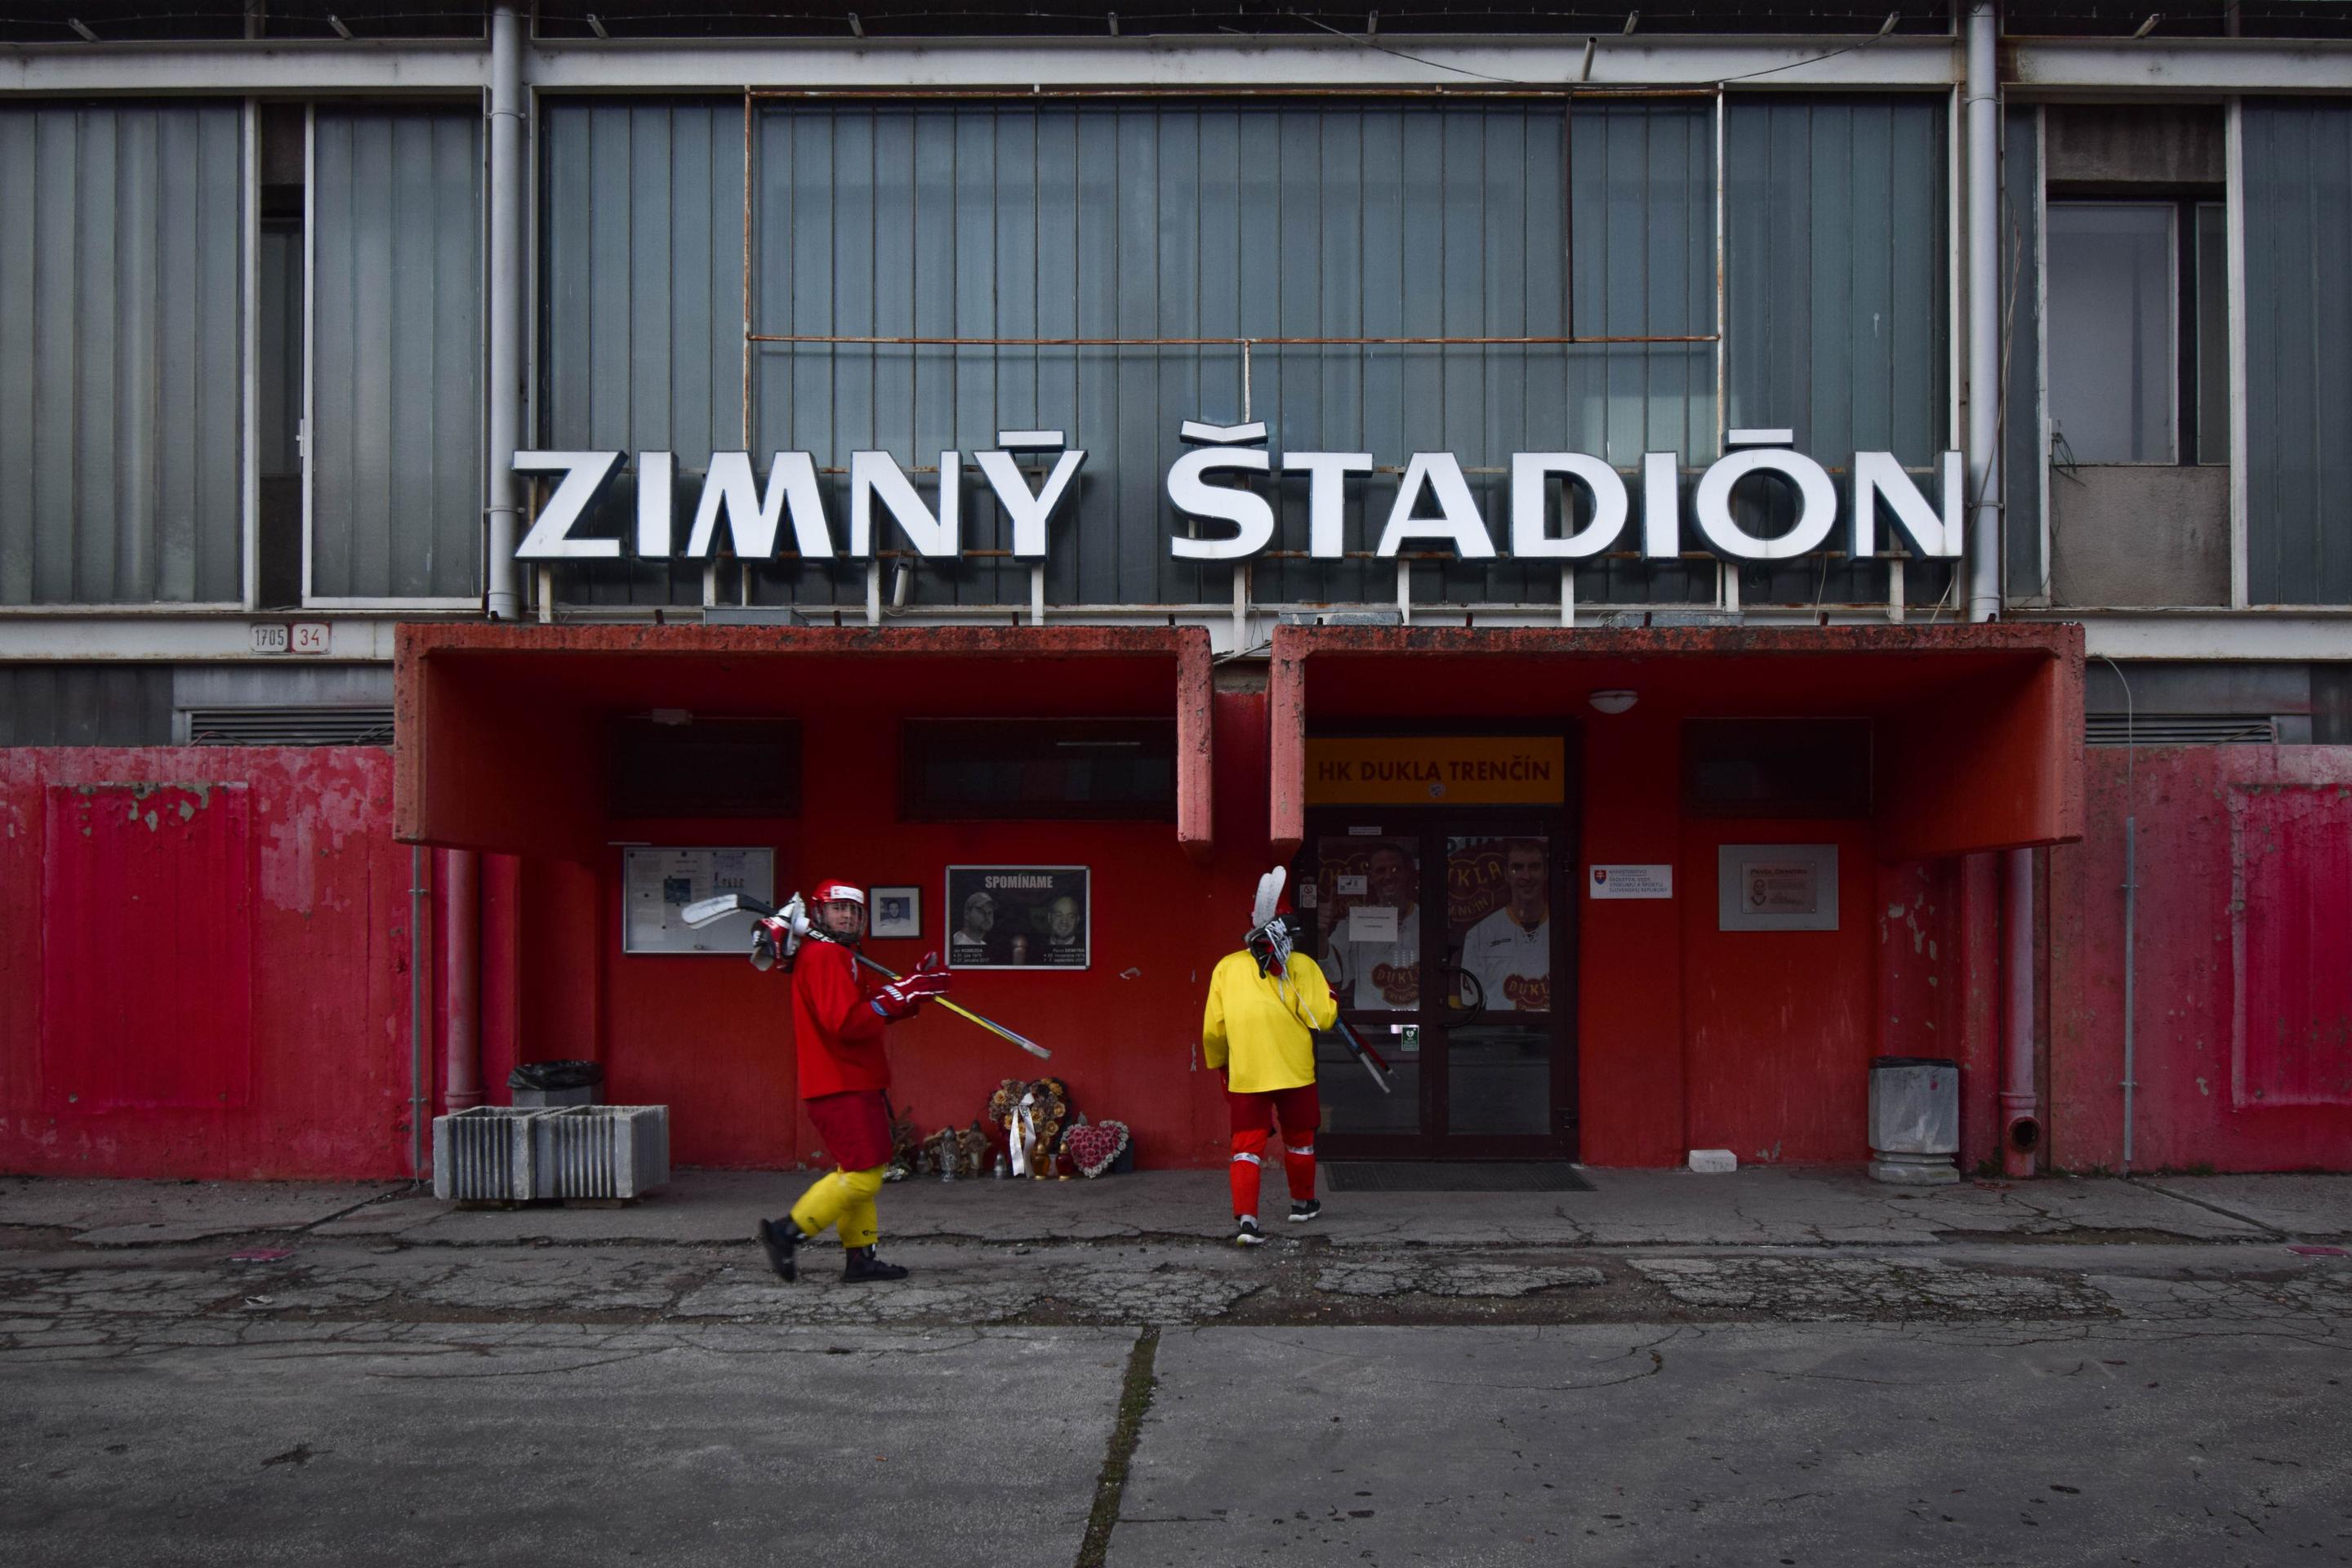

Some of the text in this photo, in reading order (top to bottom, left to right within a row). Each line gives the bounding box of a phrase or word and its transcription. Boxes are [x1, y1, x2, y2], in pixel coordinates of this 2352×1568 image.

[256, 629, 284, 646] 1705
[301, 629, 319, 646] 34
[1318, 755, 1551, 781] HK DUKLA TRENČÍN
